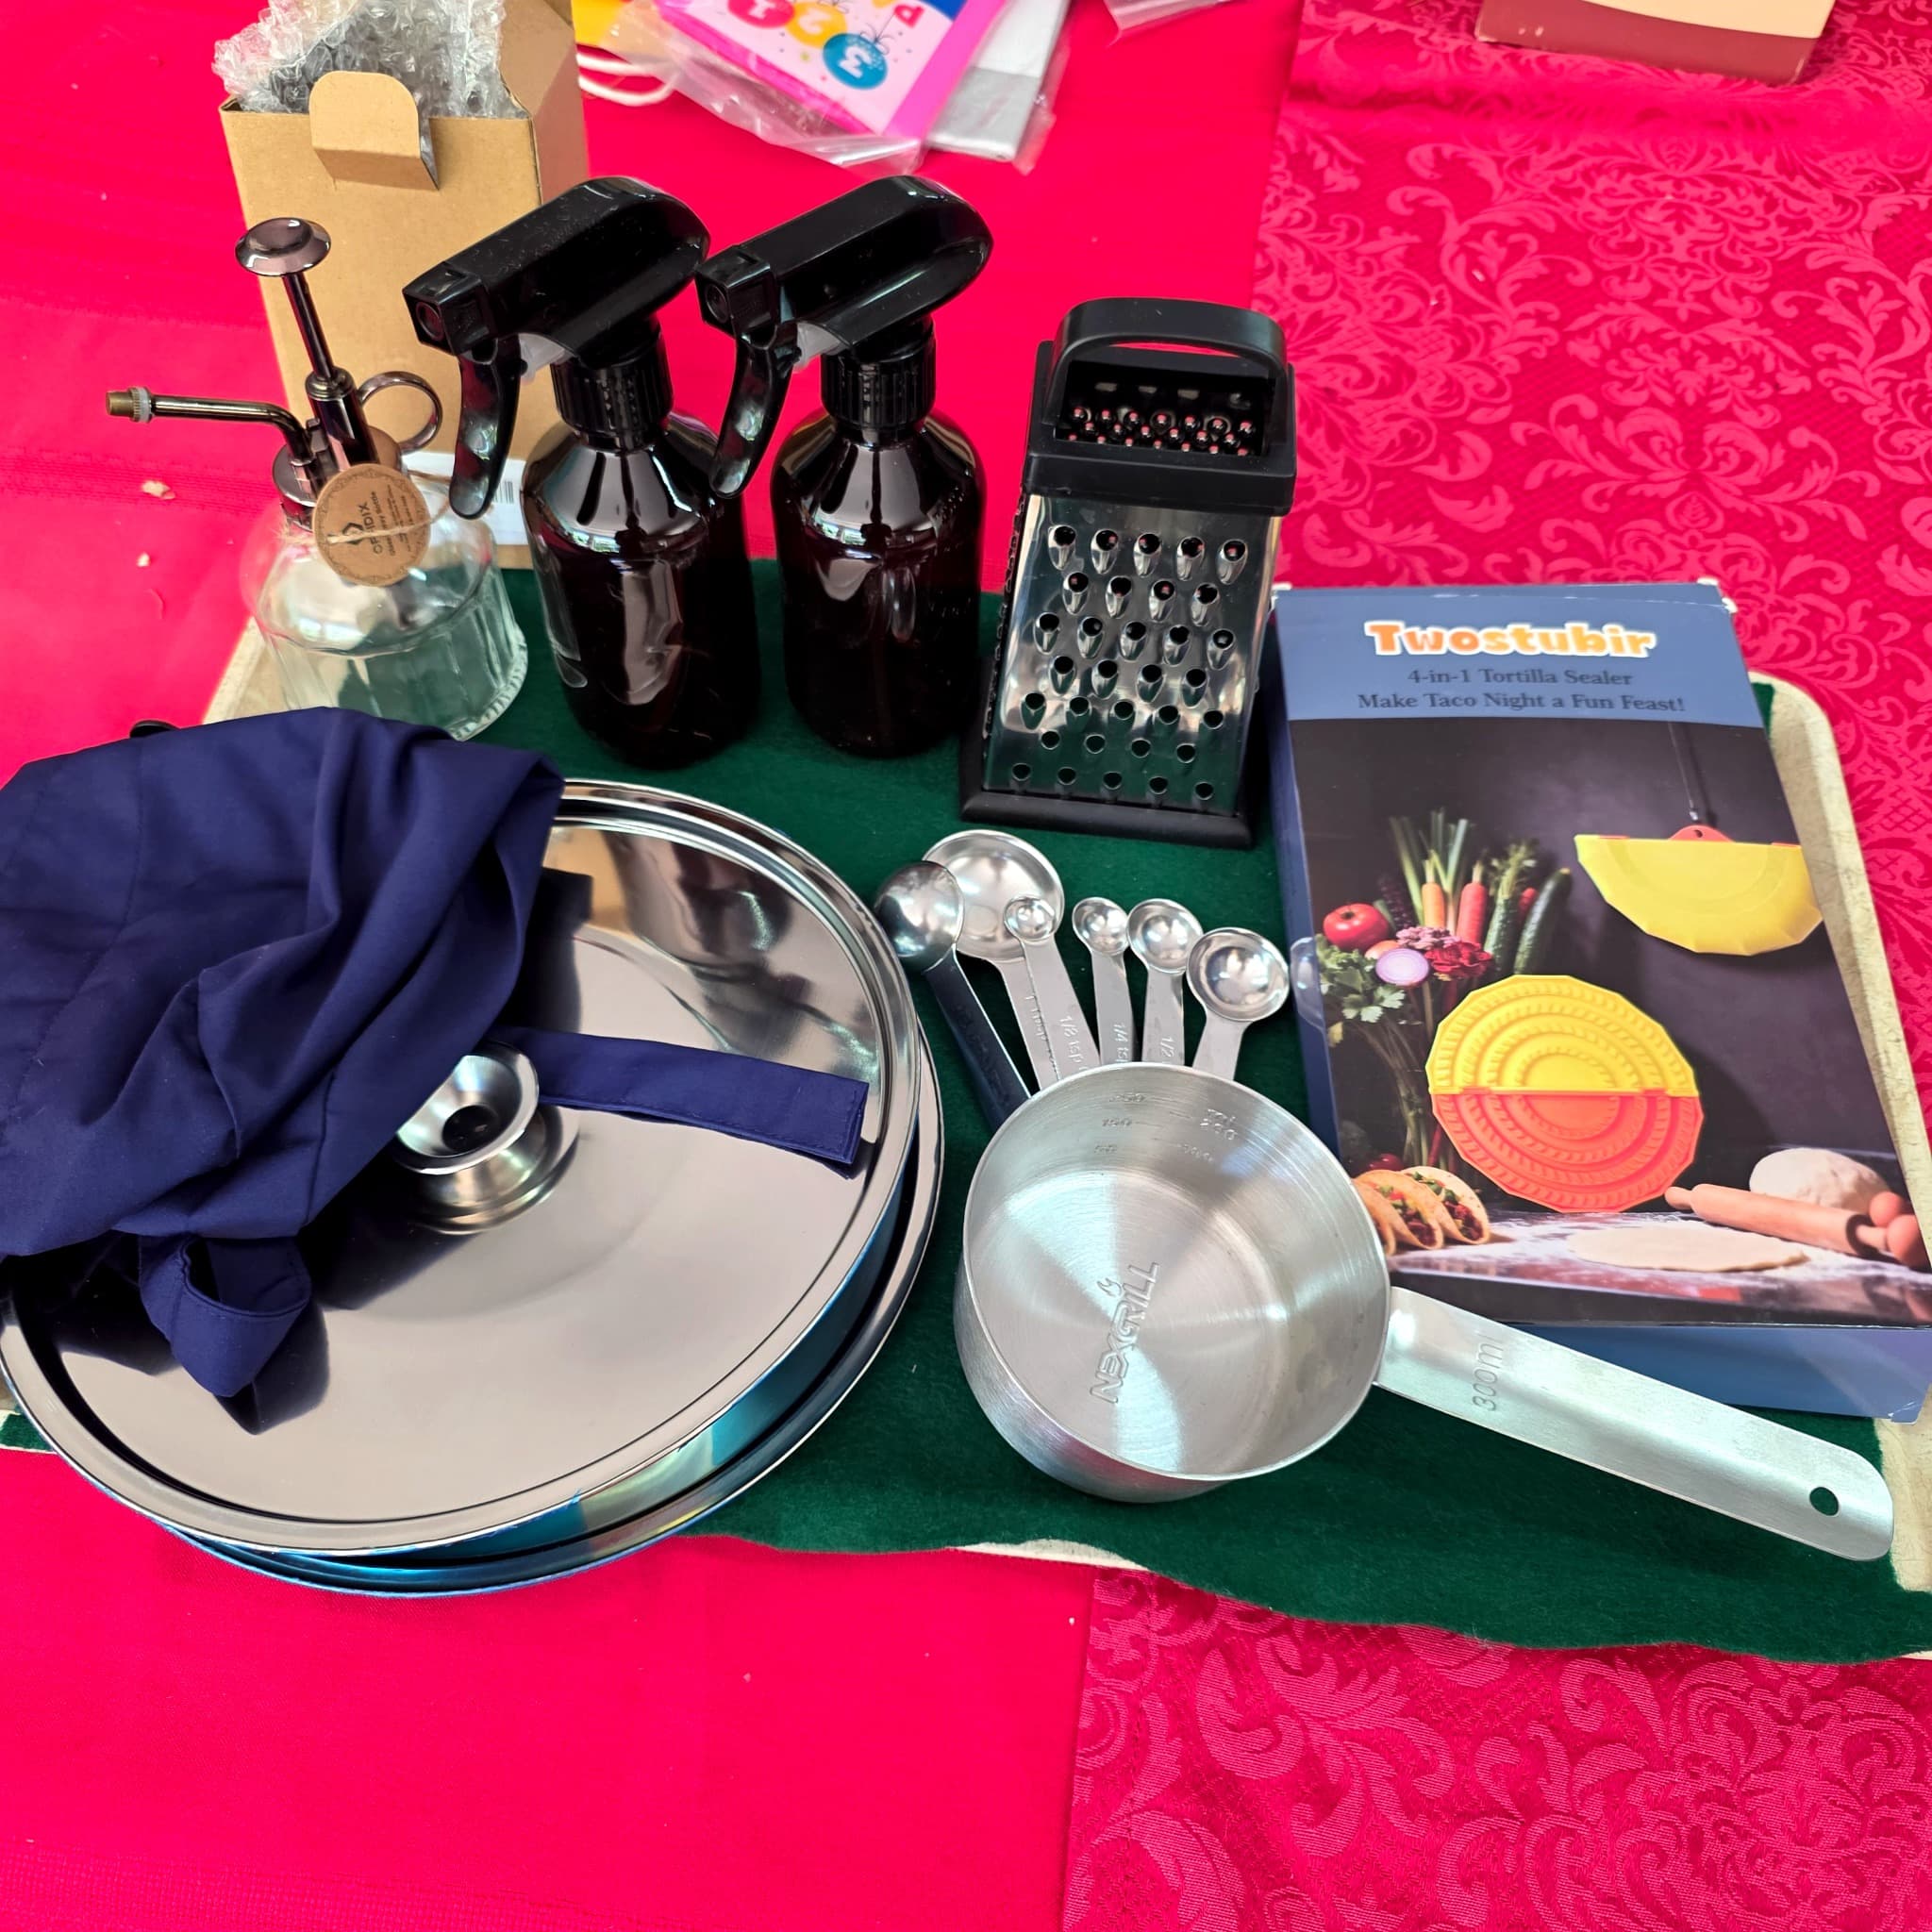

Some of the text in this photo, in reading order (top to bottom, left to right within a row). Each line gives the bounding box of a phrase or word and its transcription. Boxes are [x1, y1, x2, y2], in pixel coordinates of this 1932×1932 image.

[799, 8, 833, 35] 2
[839, 45, 873, 78] 3
[358, 501, 383, 554] OFIDIX
[1364, 621, 1657, 658] Twostubir
[1407, 668, 1634, 686] 4-in-1 Tortilla Sealer
[1358, 692, 1687, 712] Make Taco Night a Fun Feast!
[1090, 1261, 1159, 1404] NEXGRILL
[1472, 1333, 1504, 1411] 300ml
